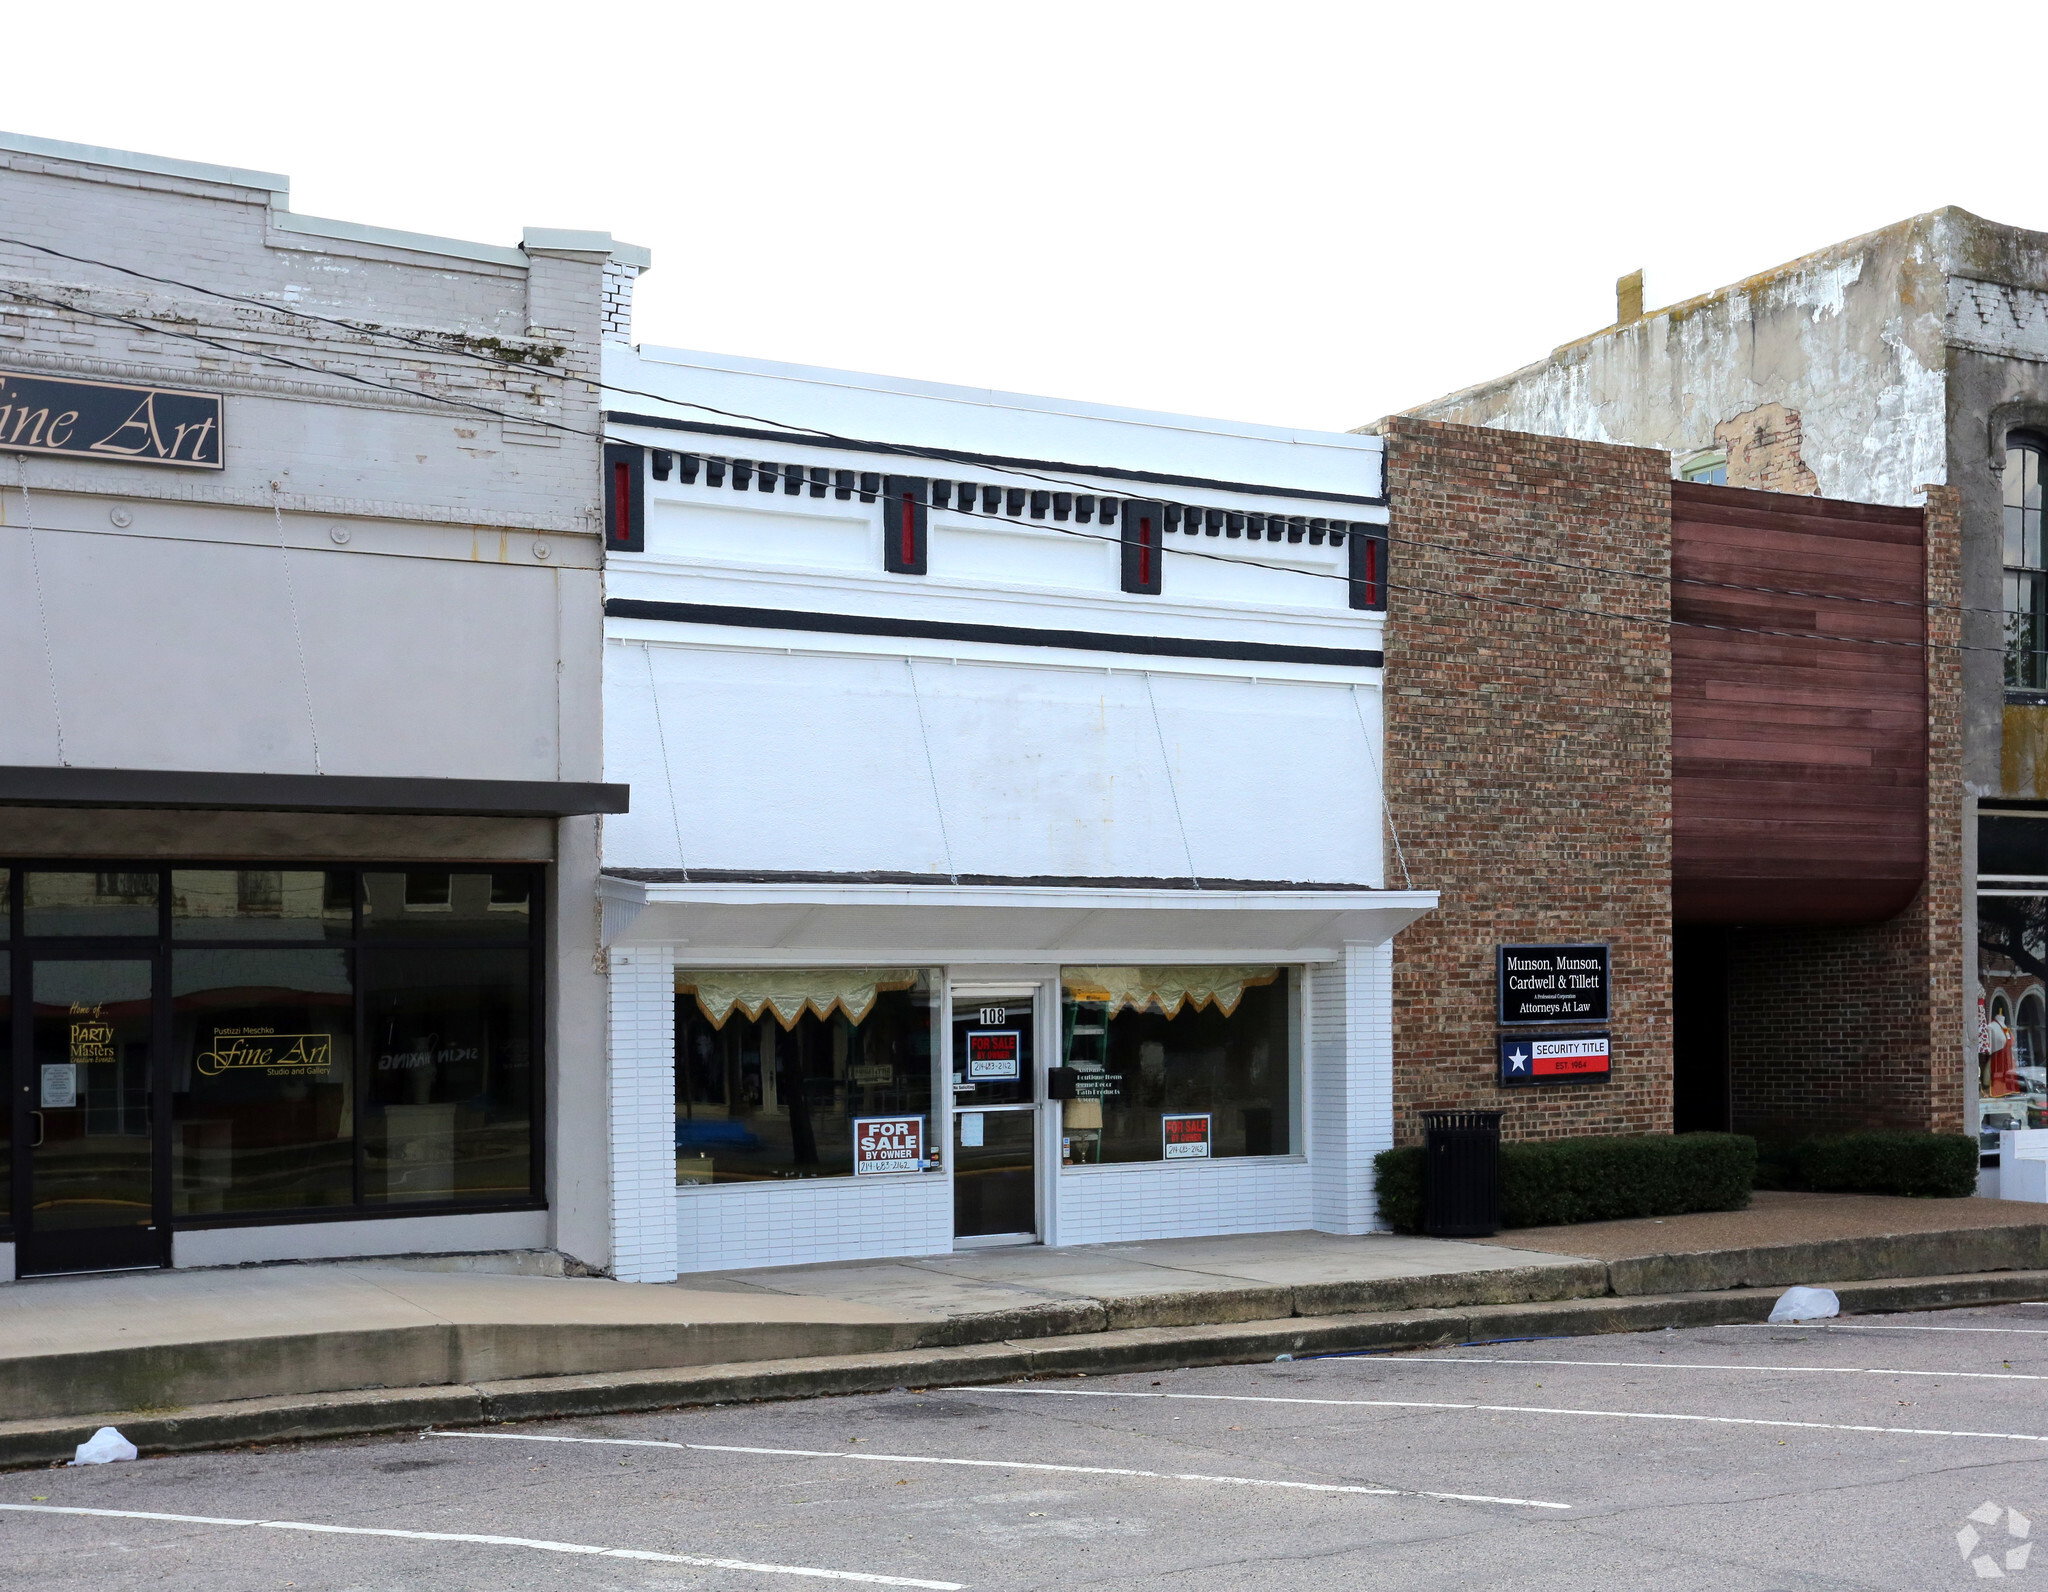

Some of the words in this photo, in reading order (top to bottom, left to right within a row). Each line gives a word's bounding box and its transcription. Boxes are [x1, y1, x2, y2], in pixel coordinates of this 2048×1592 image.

[0, 377, 79, 448] ine
[90, 391, 216, 461] Art
[1507, 956, 1553, 971] Munson,
[1556, 956, 1601, 971] Munson,
[1509, 975, 1555, 990] Cardwell
[1558, 975, 1567, 989] &
[1568, 974, 1599, 988] Tillett
[70, 1001, 90, 1014] Home
[1519, 1003, 1560, 1015] Attorneys
[1561, 1002, 1571, 1012] At
[1573, 1001, 1591, 1012] Law
[982, 1009, 1004, 1023] 108
[213, 1027, 241, 1035] Pustizzi
[972, 1038, 990, 1049] FOR
[993, 1037, 1015, 1049] SALE
[1536, 1043, 1580, 1055] SECURITY
[1582, 1042, 1605, 1053] TITLE
[70, 1045, 115, 1057] Masters
[276, 1036, 328, 1064] Art
[988, 1051, 1009, 1059] OWNER
[267, 1068, 290, 1076] Studio
[291, 1067, 305, 1075] and
[306, 1066, 331, 1075] Gallery
[1555, 1062, 1570, 1070] EST.
[869, 1123, 908, 1136] FOR
[1166, 1121, 1183, 1133] FOR
[1185, 1119, 1207, 1132] SALE
[861, 1136, 916, 1150] SALE
[866, 1151, 877, 1159] BY
[880, 1150, 912, 1159] OWNER
[860, 1161, 910, 1172] 214-683-2162
